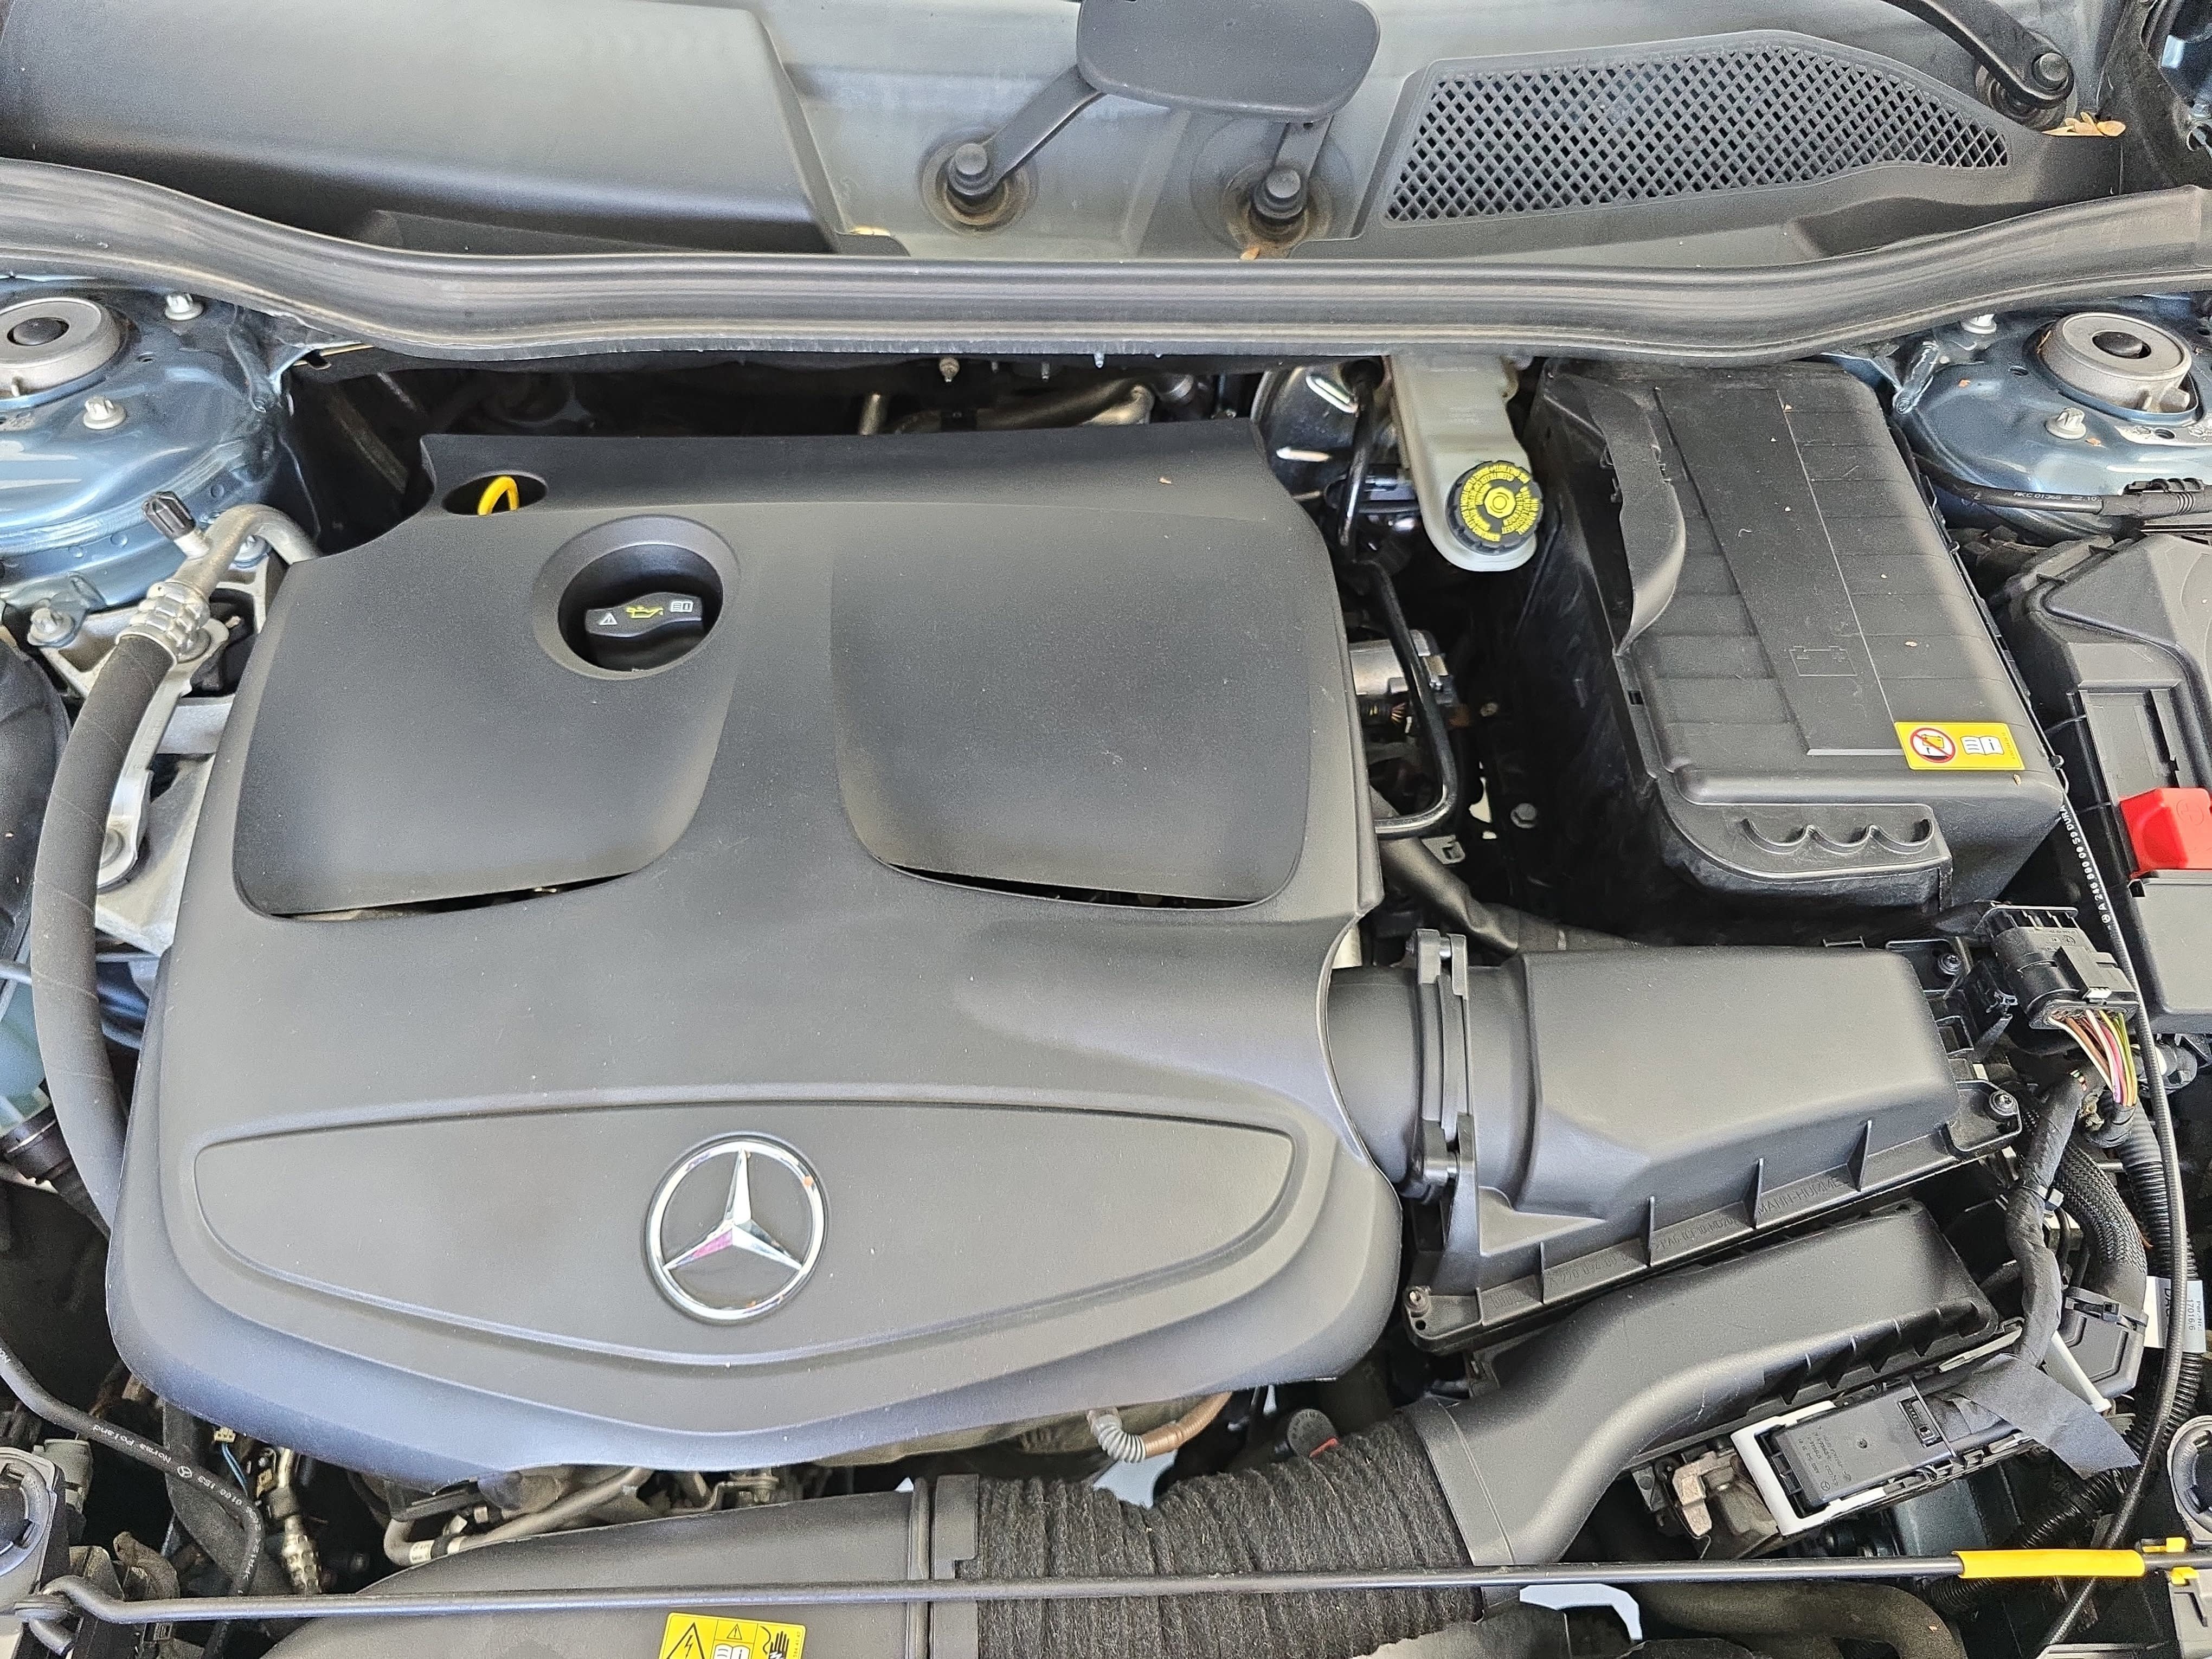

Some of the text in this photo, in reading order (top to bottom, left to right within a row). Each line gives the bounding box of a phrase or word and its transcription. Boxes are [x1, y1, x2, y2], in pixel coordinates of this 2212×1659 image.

[1472, 466, 1489, 480] BRAKE
[1507, 466, 1520, 476] ONLY
[1518, 473, 1531, 484] USE
[1463, 477, 1475, 492] FLUID
[1460, 491, 1468, 506] FROM
[1468, 472, 1515, 531] CLEAN FILLER CAP BEFORE REMOVING
[1503, 492, 1524, 526] VERWENDEN
[1515, 499, 1539, 535] NUR ORIGINAL
[1461, 511, 1475, 529] SEALED
[1471, 526, 1501, 542] CONTAINER
[2060, 805, 2075, 831] DURA
[2076, 846, 2087, 859] 00
[2090, 882, 2104, 901] 246
[2098, 902, 2107, 911] A
[2187, 1299, 2196, 1331] 17016/6
[92, 1424, 135, 1446] Poland
[138, 1443, 172, 1464] Norma
